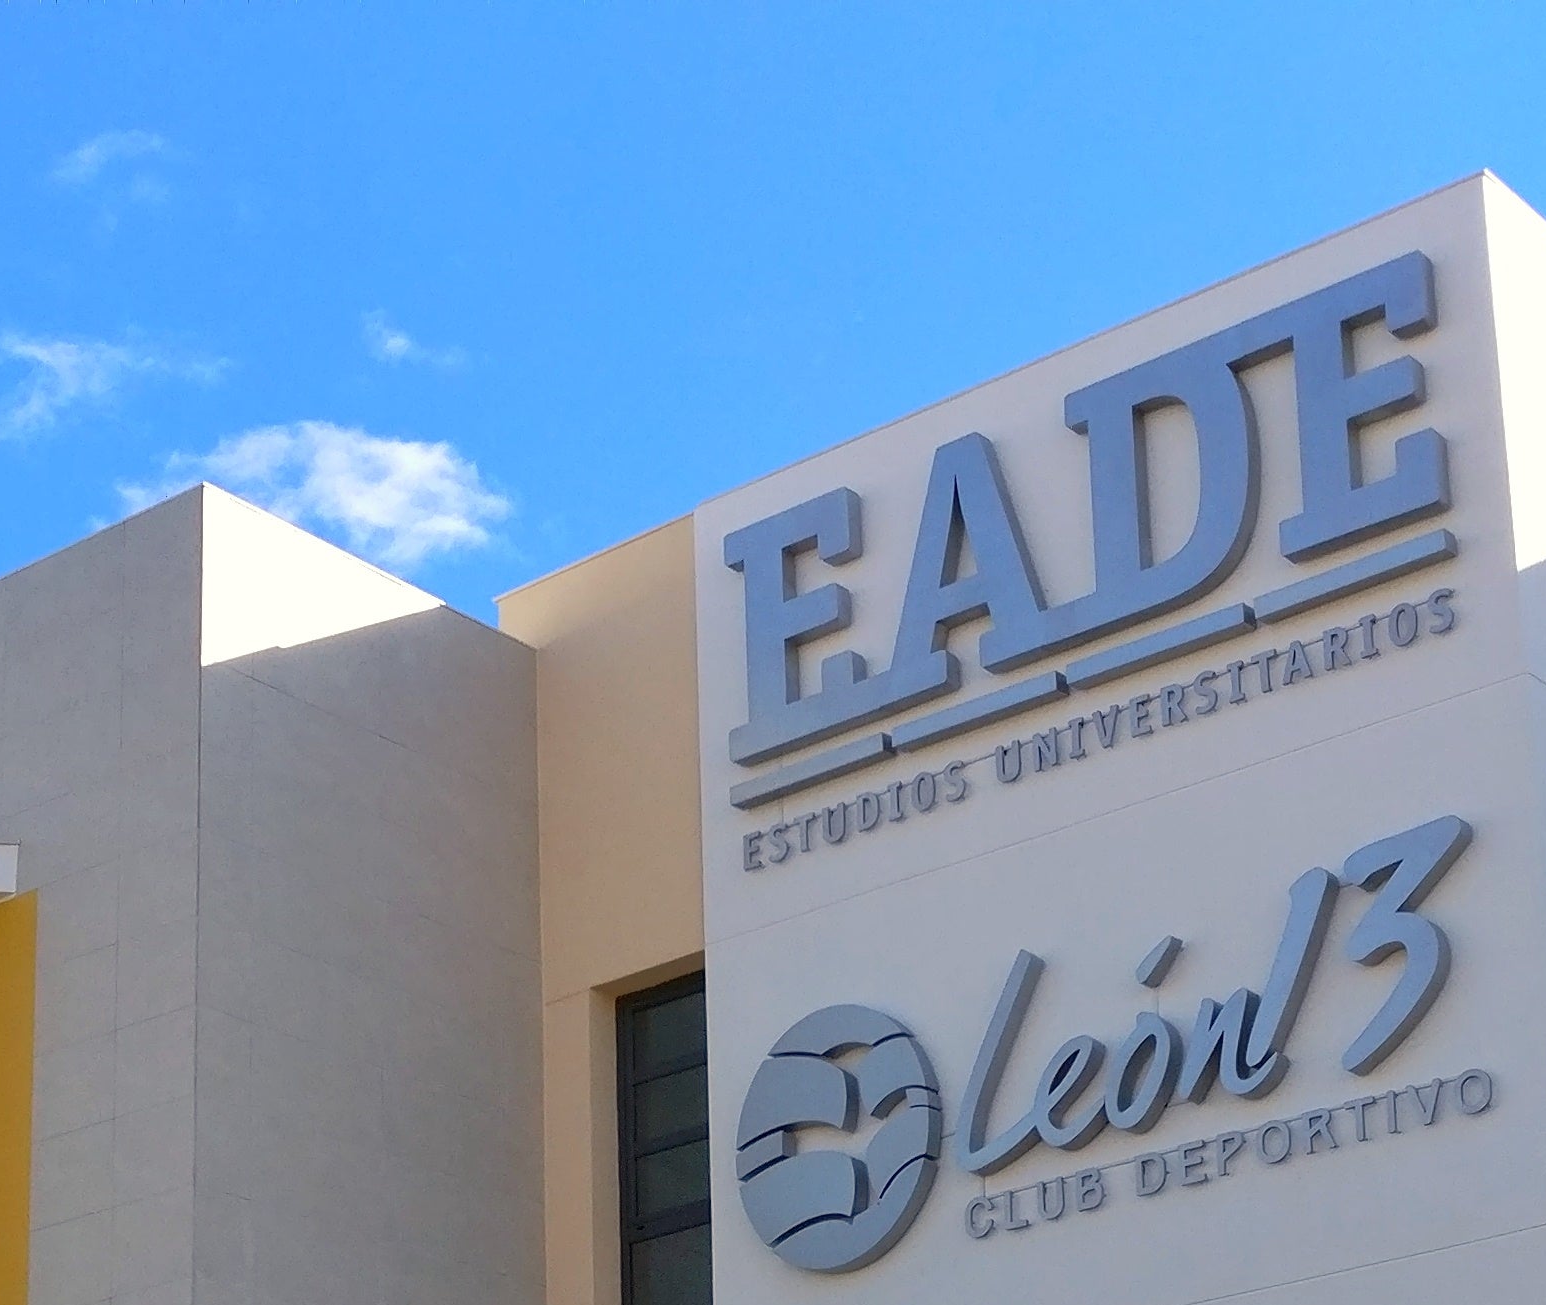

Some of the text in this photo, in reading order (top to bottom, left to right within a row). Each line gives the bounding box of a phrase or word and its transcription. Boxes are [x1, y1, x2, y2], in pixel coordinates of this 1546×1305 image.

[725, 251, 1449, 764] EADE
[742, 587, 1457, 872] ESTUDIOS UNIVERSITARIOS
[964, 1068, 1494, 1239] CLUB DEPORTIVO
